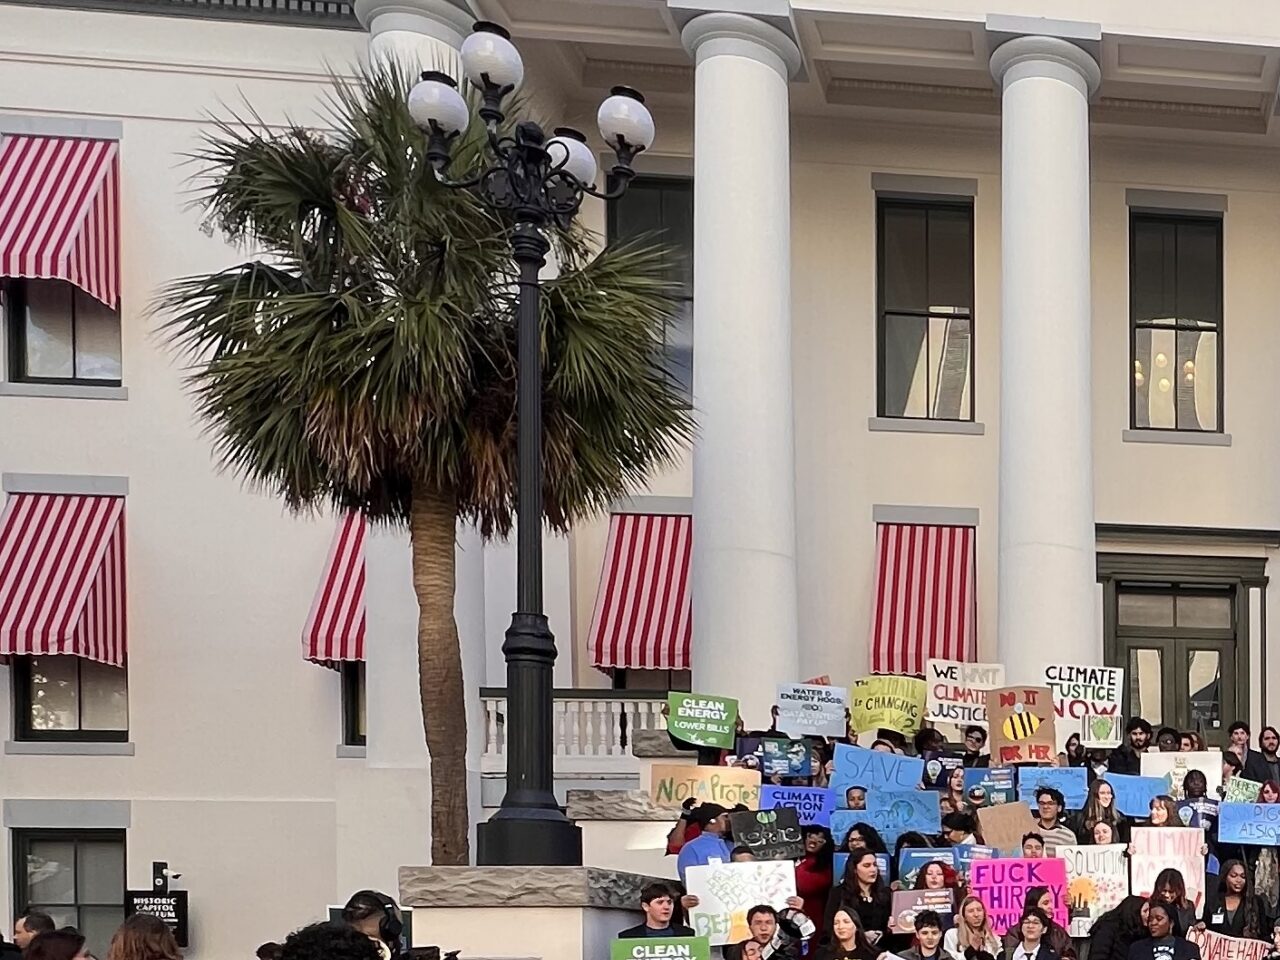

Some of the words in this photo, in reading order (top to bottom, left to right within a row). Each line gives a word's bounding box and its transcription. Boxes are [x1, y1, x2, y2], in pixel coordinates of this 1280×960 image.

[933, 664, 958, 681] WE
[1045, 665, 1116, 686] CLIMATE
[780, 693, 816, 702] ENERGY
[792, 687, 823, 697] WATER
[932, 683, 987, 702] CLIMATE
[1023, 690, 1039, 705] IT
[1047, 682, 1116, 702] JUSTICE
[682, 698, 725, 711] CLEAN
[865, 696, 918, 718] CHANGING
[931, 704, 989, 721] JUSTICE
[1052, 700, 1119, 718] NOW
[677, 706, 729, 721] ENERGY
[674, 720, 706, 732] LOWER
[706, 722, 730, 735] BILLS
[1028, 744, 1051, 761] HER
[844, 751, 913, 787] SAVE
[656, 775, 697, 802] NOT
[772, 791, 825, 802] CLIMATE
[774, 801, 824, 812] ACTION
[1239, 823, 1255, 836] AI
[1133, 831, 1202, 858] CLIMATE
[975, 862, 1044, 884] FUCK
[133, 897, 178, 905] HISTORIC
[632, 944, 691, 959] CLEAN
